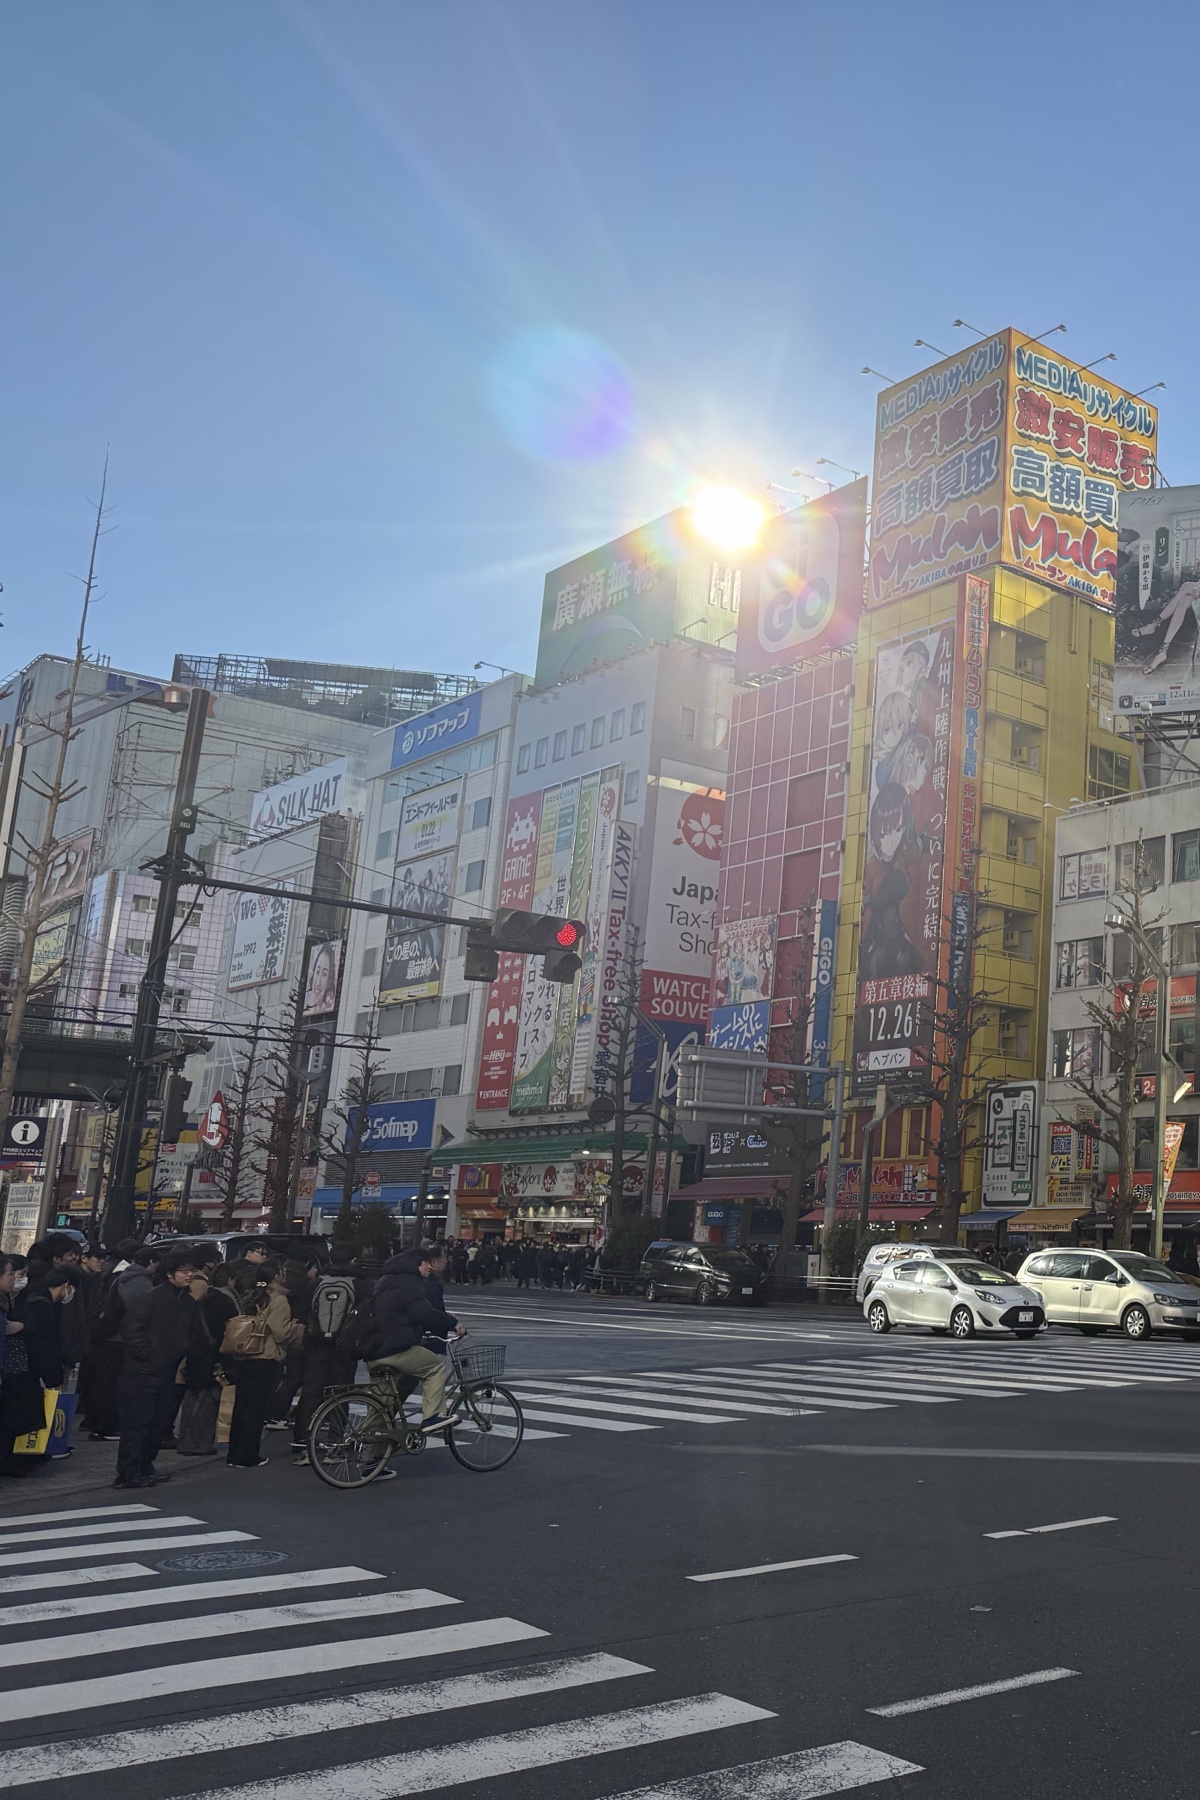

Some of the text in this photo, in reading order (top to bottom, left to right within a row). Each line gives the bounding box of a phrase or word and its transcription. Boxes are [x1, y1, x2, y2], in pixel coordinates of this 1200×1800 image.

[880, 337, 1005, 432] MEDIAリサイクル
[1016, 347, 1153, 436] MEDIAリサイクル
[878, 379, 1004, 481] 激安販売
[1015, 386, 1153, 488] 激安販売
[874, 436, 998, 538] 高額買取
[1011, 445, 1118, 525] 高額買
[871, 504, 1000, 601] Mulan
[1009, 504, 1117, 578] Mula
[1158, 536, 1165, 557] リン
[919, 566, 947, 586] AKIBA
[1023, 556, 1099, 596] ムーラン AKIBA
[418, 708, 470, 746] ソフマップ
[277, 773, 342, 827] SILK HAT
[404, 796, 451, 825] エンドフィールド
[504, 854, 531, 883] GAME
[240, 899, 257, 921] We
[501, 884, 531, 905] 2F 4F
[666, 903, 716, 928] Tax-f
[243, 942, 257, 956] 1992
[602, 906, 626, 991] Tax-free
[818, 937, 833, 984] GiGO
[406, 954, 441, 981] 最前線へ
[865, 972, 929, 1004] 第五章後編
[651, 998, 708, 1021] SOUVE
[869, 1004, 912, 1042] 12.26
[490, 1051, 505, 1062] Hey
[483, 1088, 508, 1099] ENTRANCE
[372, 1116, 418, 1142] Sofmap
